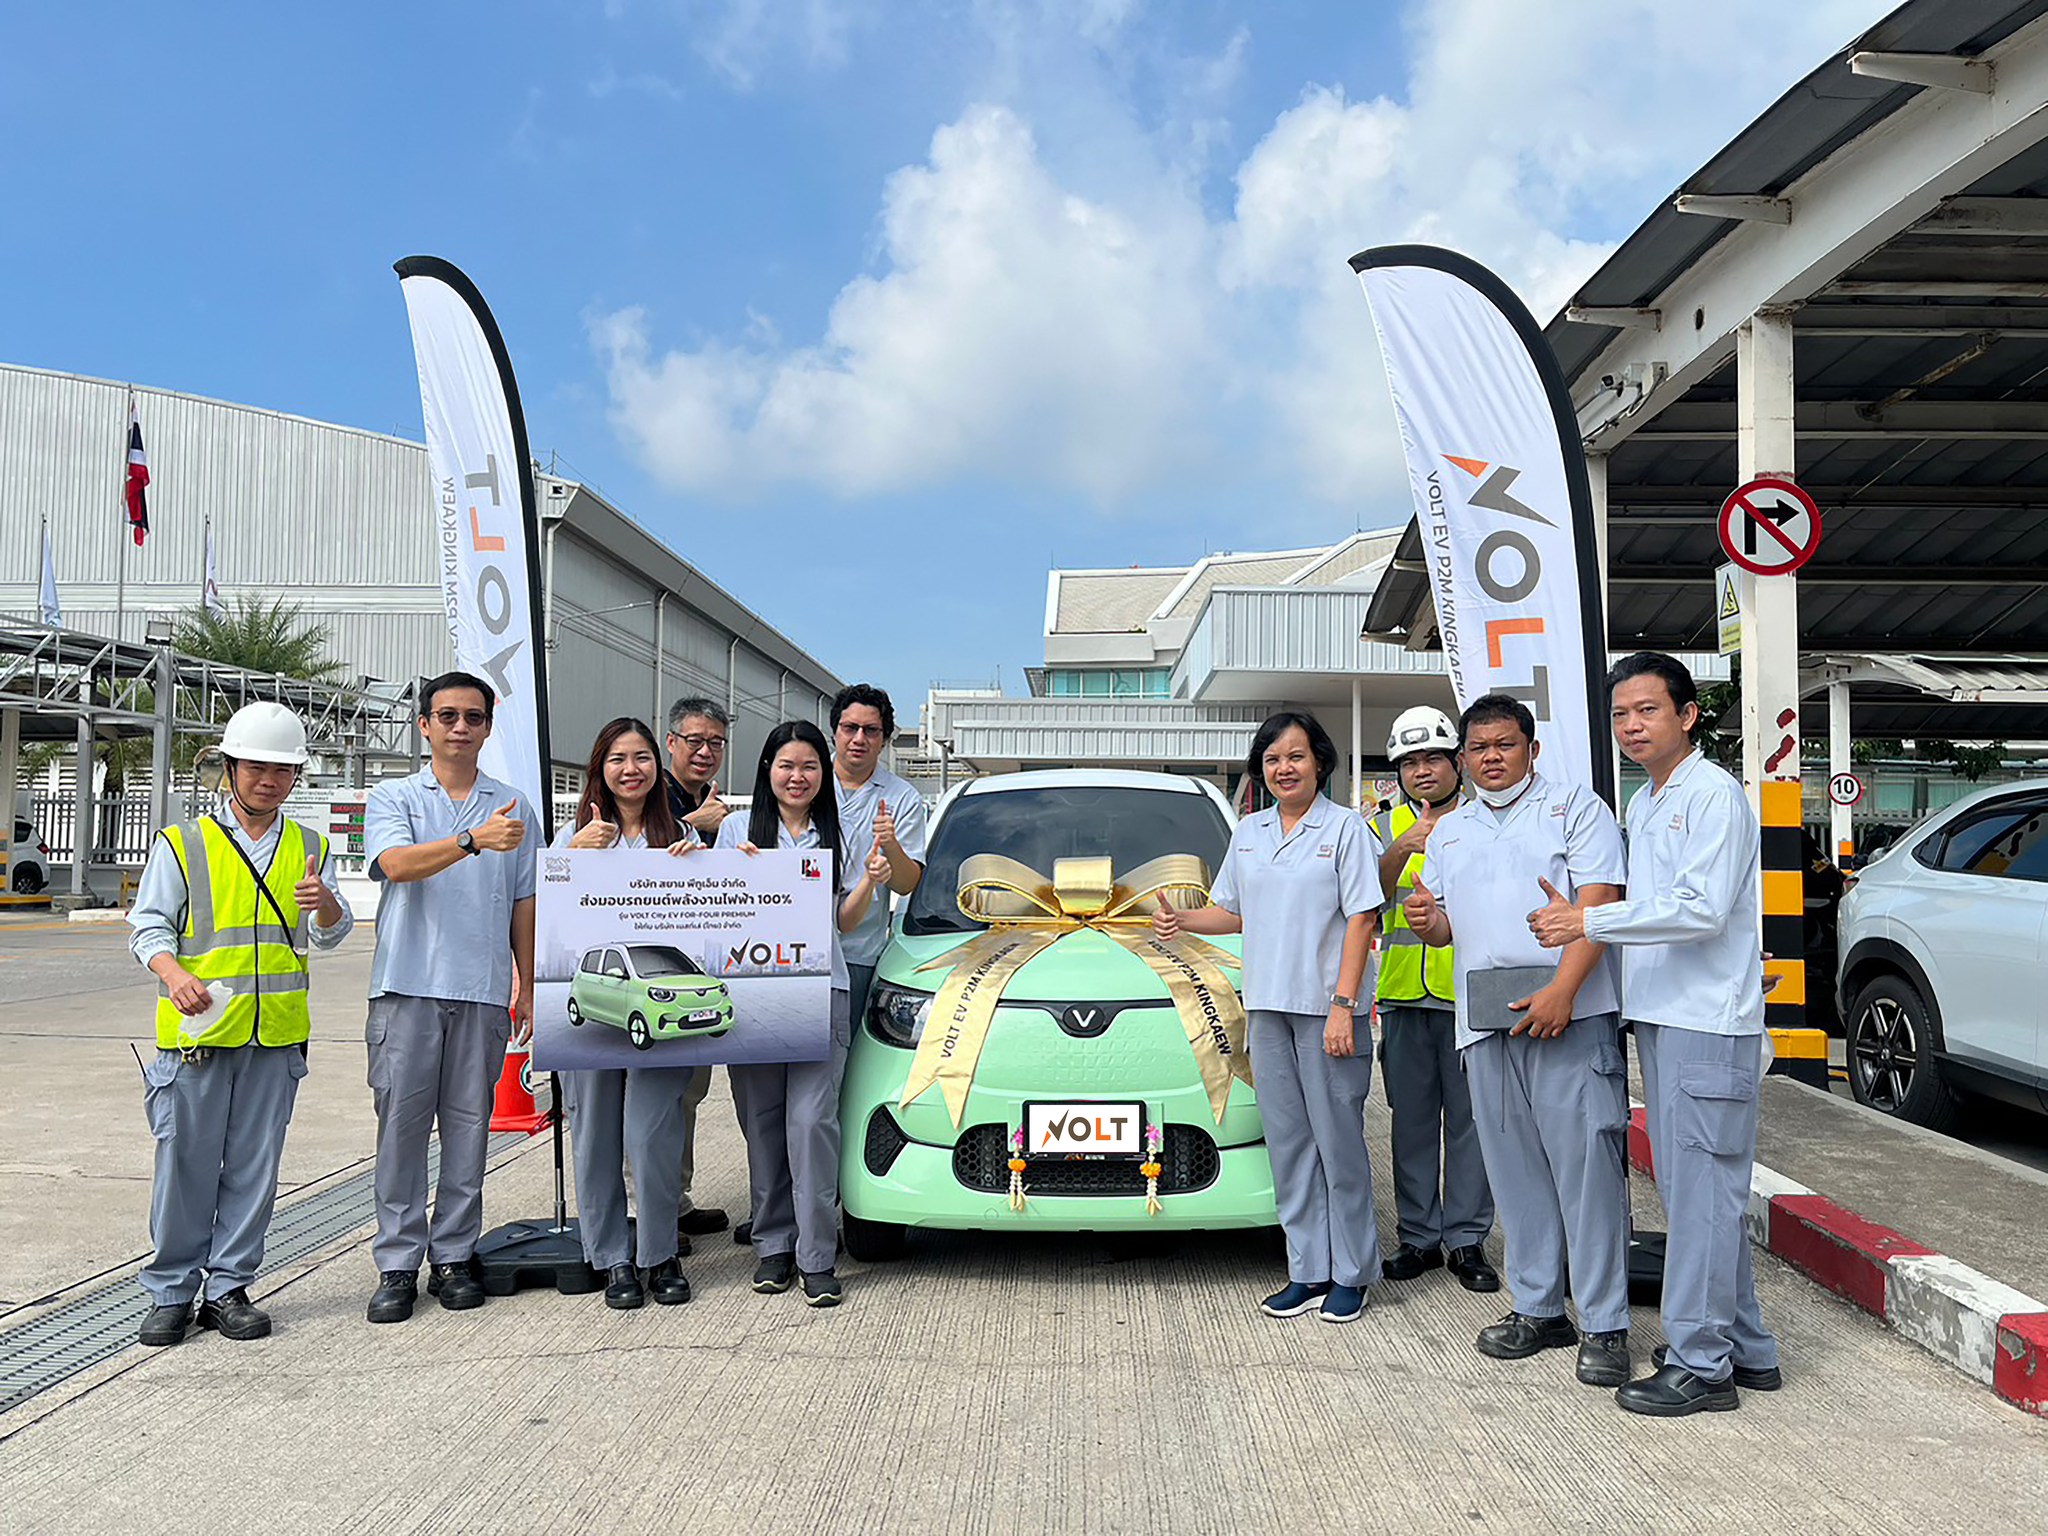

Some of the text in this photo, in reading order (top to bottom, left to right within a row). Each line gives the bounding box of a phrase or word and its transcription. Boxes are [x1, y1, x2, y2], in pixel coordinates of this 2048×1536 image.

[1427, 470, 1446, 519] VOLT
[1433, 526, 1450, 550] EV
[1437, 555, 1453, 594] P2M
[1440, 453, 1560, 722] VOLT
[1833, 779, 1855, 795] 10
[580, 892, 792, 906] ส่งมอบรถยนต์พลังงานไฟฟ้า 100%
[629, 877, 747, 891] บริษัท สยาม พีทูเอ็ม จำกัด
[724, 936, 807, 973] VOLT
[941, 1025, 960, 1058] VOLT
[953, 1004, 968, 1022] EV
[961, 976, 982, 1001] P2M
[1178, 963, 1201, 982] P2M
[1194, 984, 1232, 1055] KINGKAEW
[1041, 1108, 1128, 1148] VOLT
